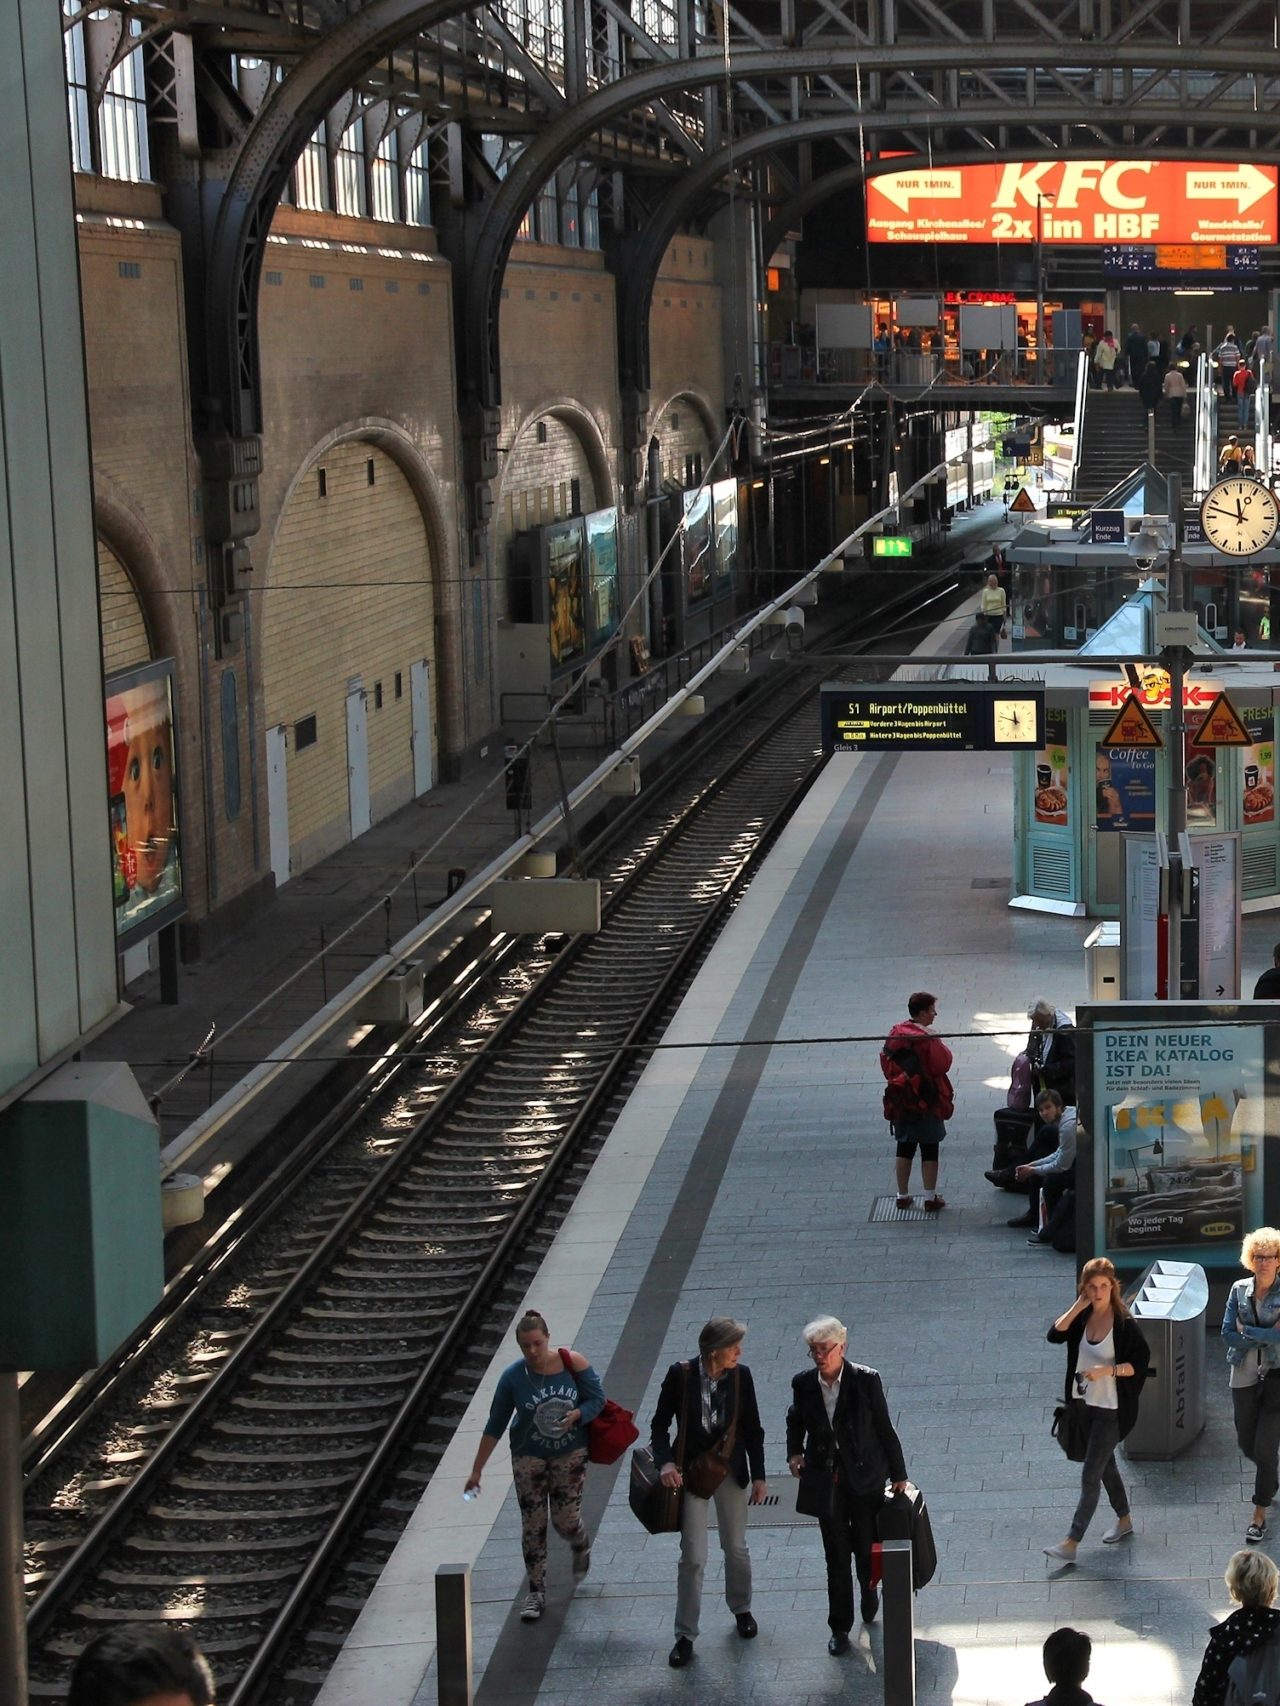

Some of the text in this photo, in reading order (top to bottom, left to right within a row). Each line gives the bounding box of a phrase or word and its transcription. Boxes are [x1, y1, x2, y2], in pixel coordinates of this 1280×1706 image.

[897, 180, 920, 189] NUR
[991, 161, 1152, 209] KFC
[1194, 181, 1217, 189] NUR
[868, 219, 914, 230] Ausgang
[992, 212, 1160, 239] 2x im HBF
[1198, 220, 1265, 230] Wandelhalle/
[887, 231, 968, 242] Schauspielhaus
[1191, 232, 1272, 242] Gourmetstation
[1095, 525, 1120, 534] Kurzzug
[849, 702, 967, 717] S1 Airport/Poppenbüttel
[924, 720, 946, 728] Airport
[1109, 749, 1149, 763] Coffee
[1105, 1035, 1212, 1047] DEIN NEUER
[1105, 1049, 1234, 1062] IKEA KATALOG
[1105, 1065, 1171, 1077] IST DA!
[1117, 1098, 1228, 1130] IKEA
[1128, 1215, 1184, 1226] Wo jeder Tag
[1128, 1225, 1161, 1234] beginnt
[525, 1385, 578, 1410] OAKLAND
[1175, 1354, 1185, 1430] Abfall
